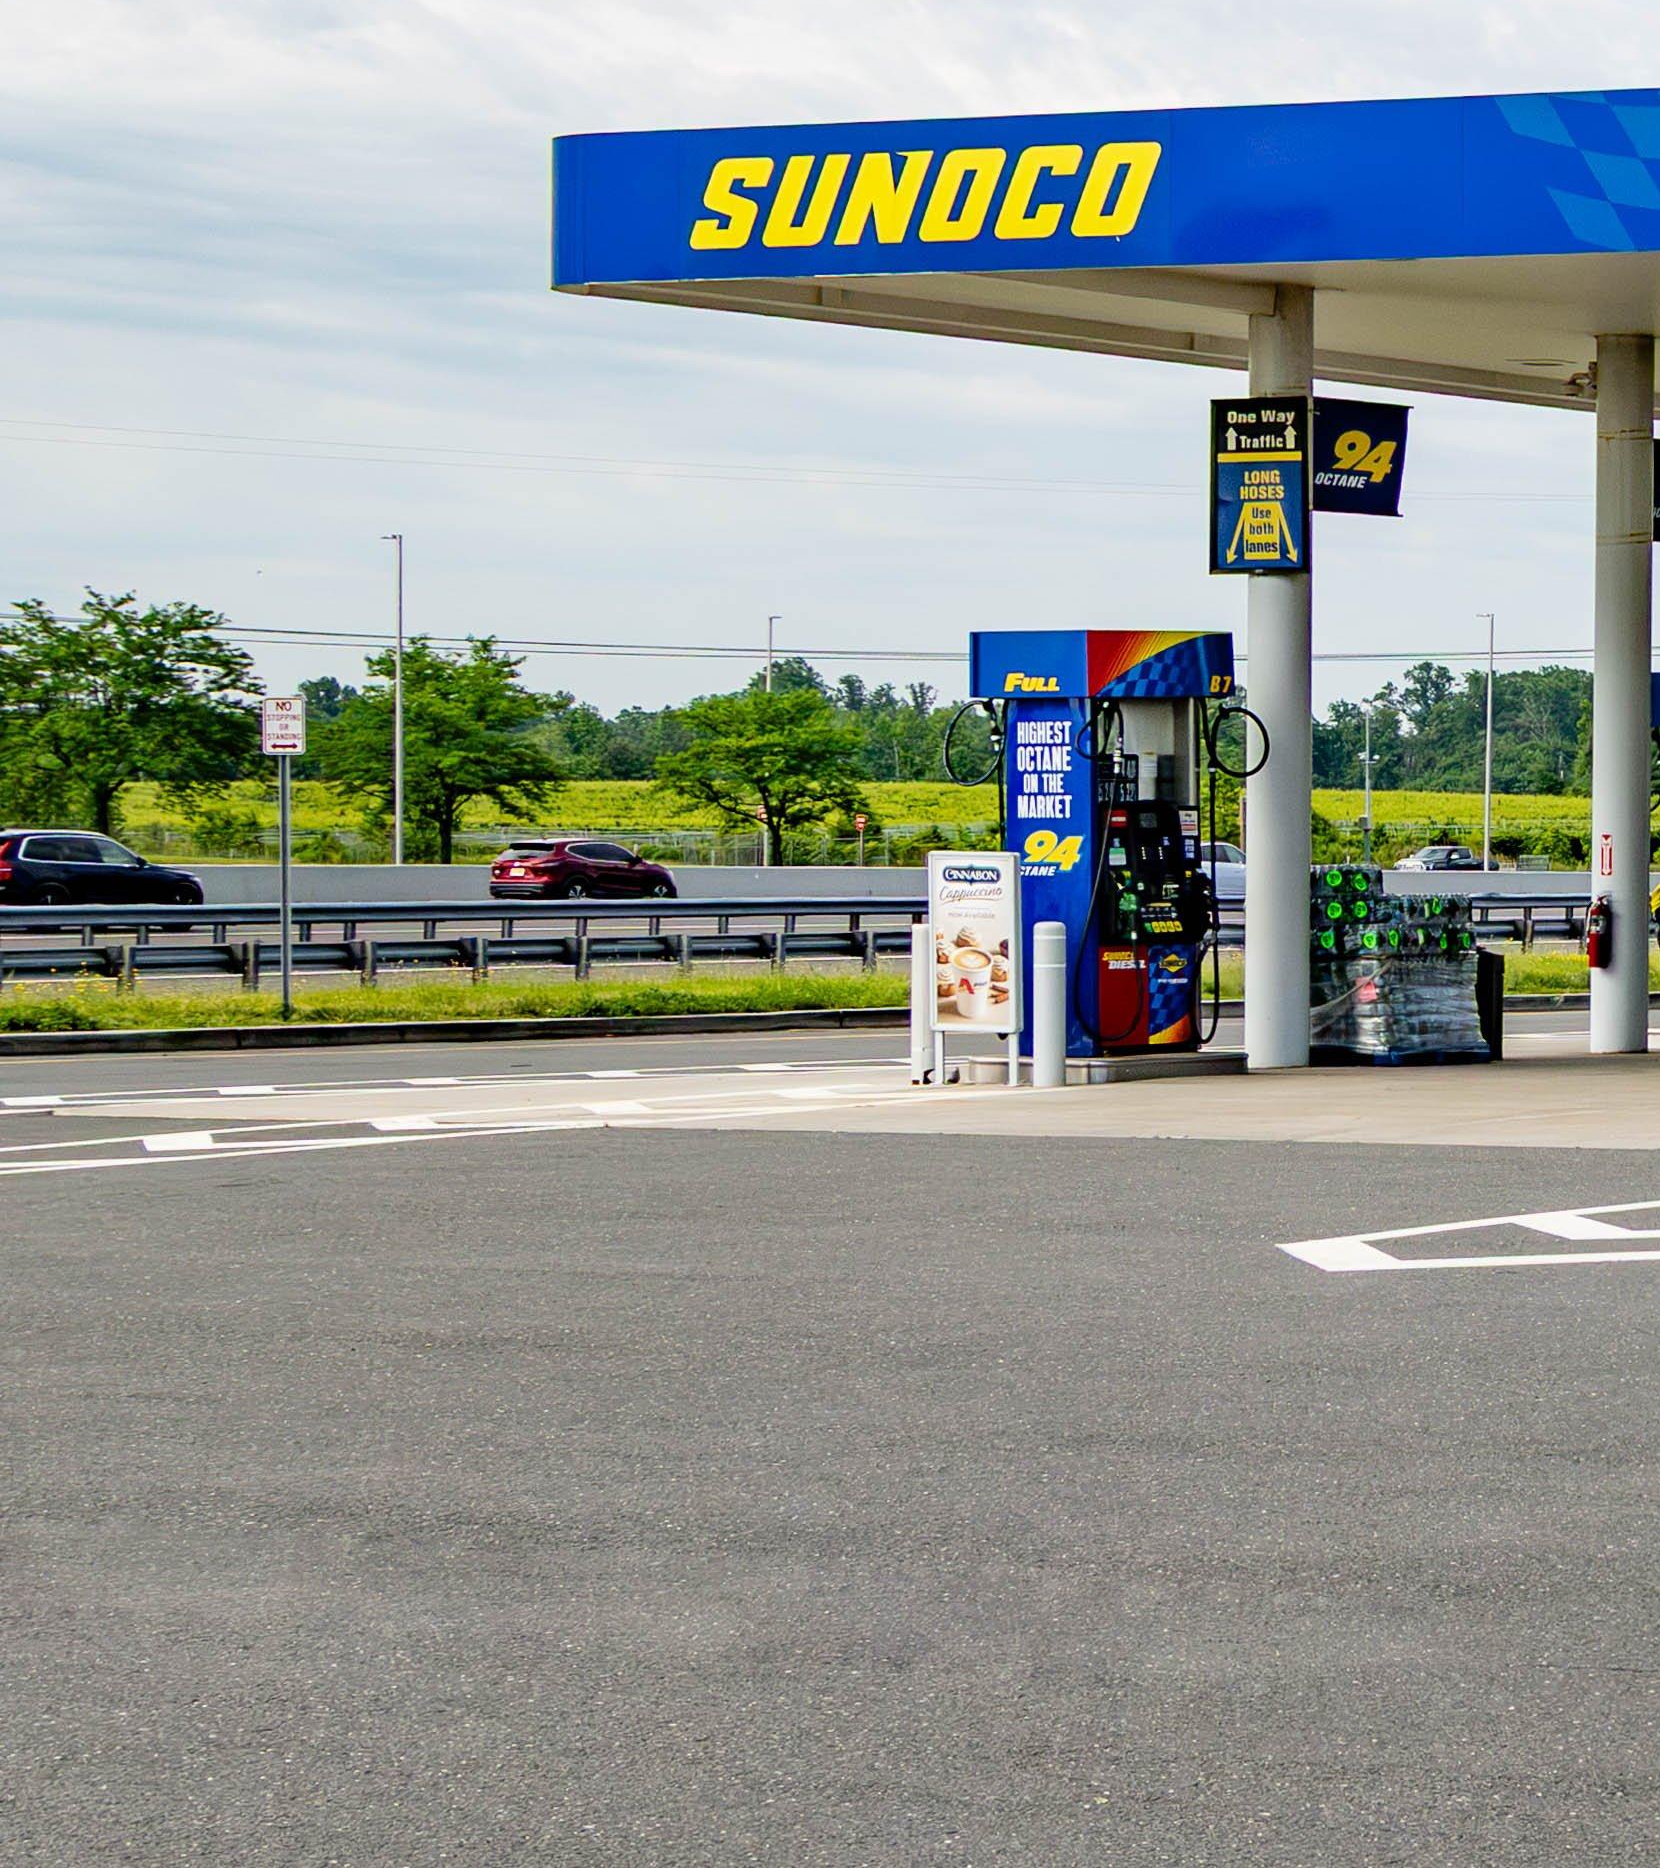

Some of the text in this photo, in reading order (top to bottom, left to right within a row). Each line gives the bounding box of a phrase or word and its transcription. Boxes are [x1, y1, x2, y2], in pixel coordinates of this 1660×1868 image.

[689, 141, 1162, 249] SUNOCO
[1227, 410, 1295, 425] One Way
[1239, 435, 1284, 449] Traffic
[1332, 430, 1397, 483] 94
[1244, 469, 1280, 484] LONG
[1314, 472, 1368, 489] OCTANE
[1240, 485, 1285, 500] HOSES
[1252, 508, 1271, 519] Use
[1249, 523, 1274, 535] both
[1245, 539, 1278, 553] lanes
[1004, 672, 1061, 692] FULL
[1209, 675, 1232, 693] B7
[275, 701, 292, 711] NO
[1017, 721, 1072, 744] HIGHEST
[1017, 746, 1072, 772] OCTANE
[1023, 774, 1064, 794] ON THE
[1017, 795, 1073, 819] MARKET
[1023, 829, 1085, 872] 94
[945, 869, 998, 882] CINNABON
[1019, 866, 1056, 877] CTANE
[938, 886, 1003, 903] Cappuccino
[1108, 960, 1146, 970] DIESL
